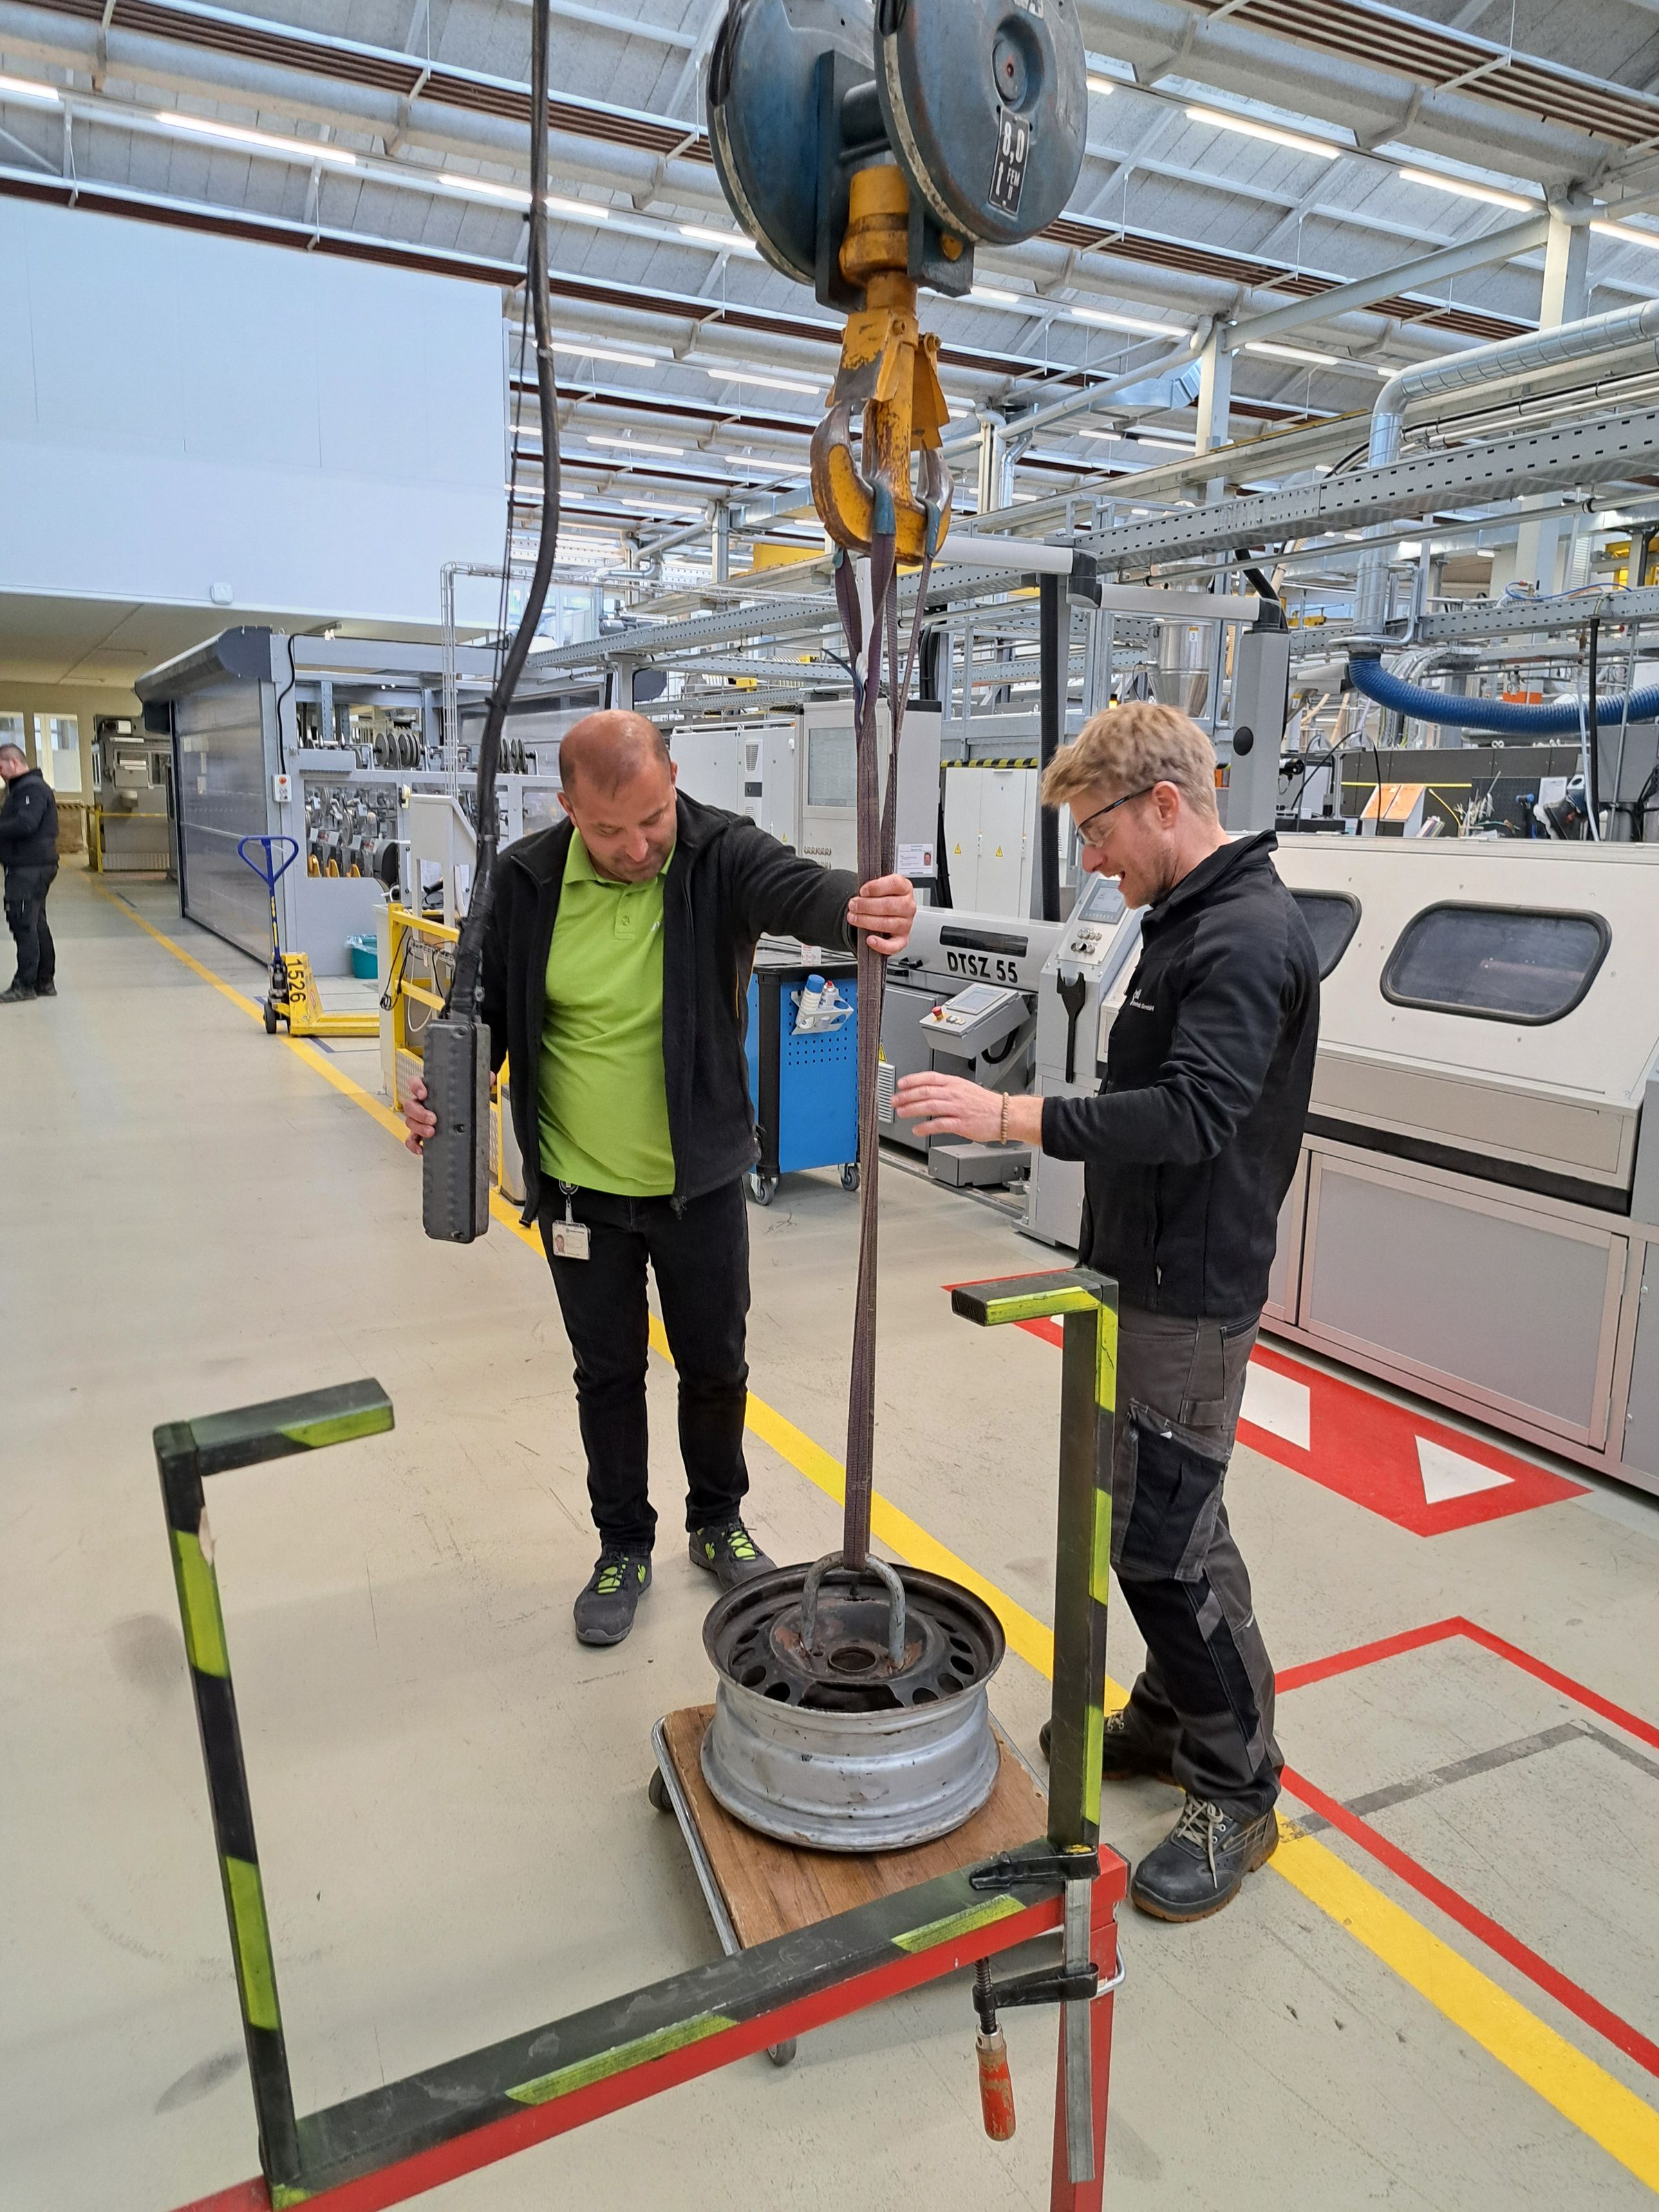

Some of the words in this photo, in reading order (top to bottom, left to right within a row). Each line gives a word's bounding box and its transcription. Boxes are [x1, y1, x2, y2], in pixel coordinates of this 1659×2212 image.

[1002, 121, 1024, 165] 8,0
[1006, 167, 1020, 187] FEM
[288, 959, 306, 1003] 1526
[947, 951, 991, 978] DTSZ
[996, 959, 1018, 984] 55
